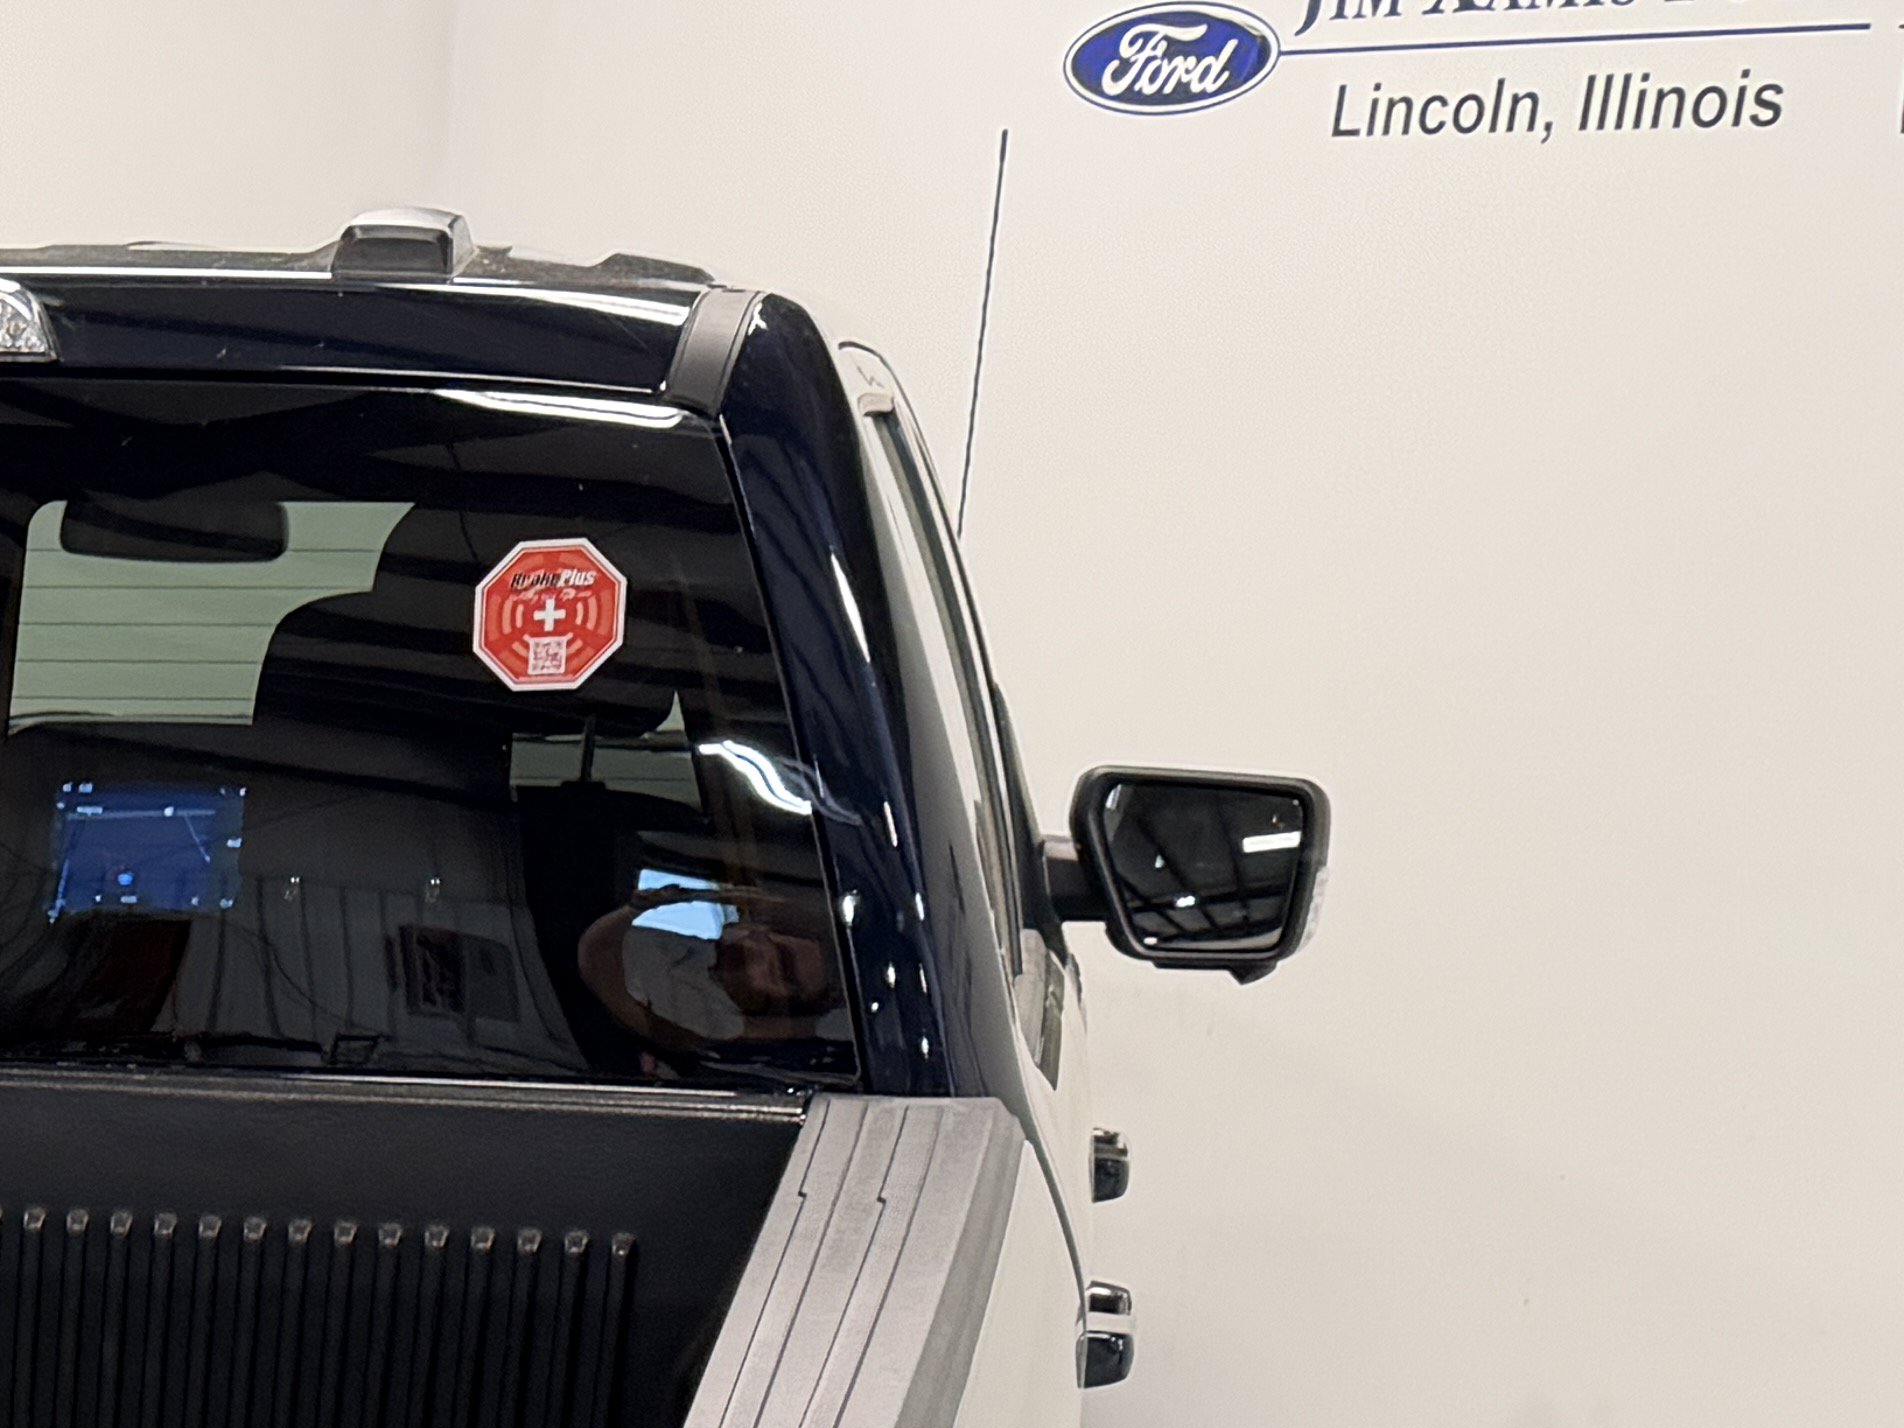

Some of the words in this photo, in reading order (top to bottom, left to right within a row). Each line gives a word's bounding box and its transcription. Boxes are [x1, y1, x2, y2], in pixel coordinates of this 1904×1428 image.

[1102, 23, 1238, 96] Ford
[1331, 78, 1553, 144] Lincoln,
[1578, 69, 1784, 131] Illinois
